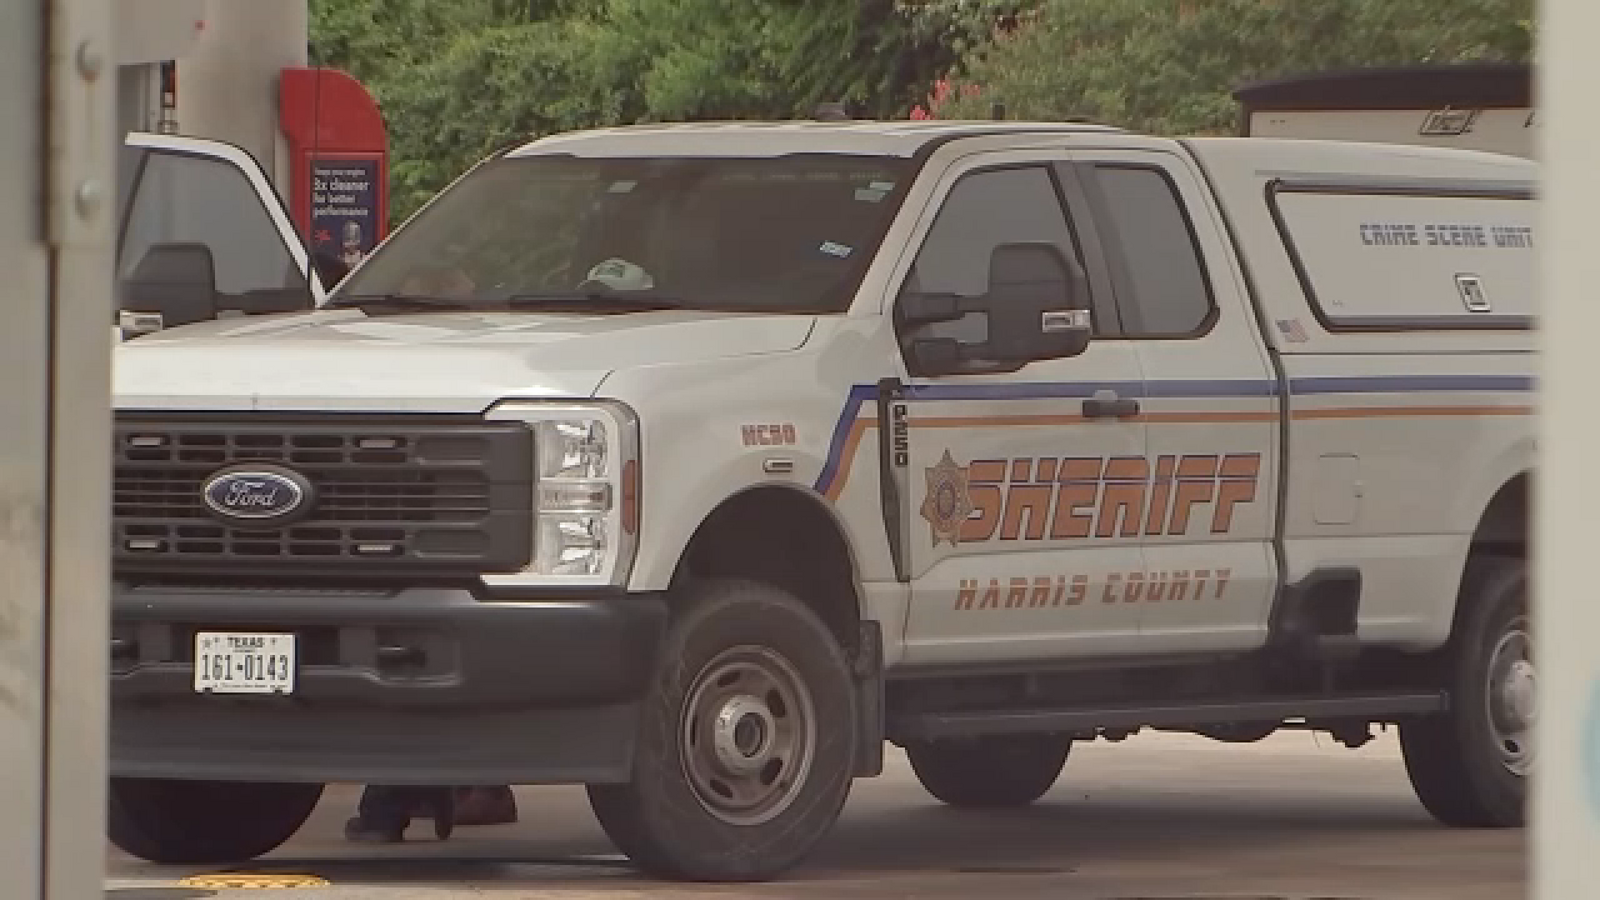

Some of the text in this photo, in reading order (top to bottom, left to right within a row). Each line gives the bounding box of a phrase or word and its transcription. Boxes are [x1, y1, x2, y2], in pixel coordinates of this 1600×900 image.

[329, 177, 370, 191] cleaner
[327, 192, 356, 204] better
[312, 205, 369, 219] performance
[1359, 224, 1420, 246] CRIME
[1424, 224, 1488, 246] SCENE
[224, 479, 279, 507] Ford
[957, 451, 1261, 543] SHERIFF
[954, 566, 1232, 611] HARRIS COUNTY
[226, 636, 266, 648] TEXAS
